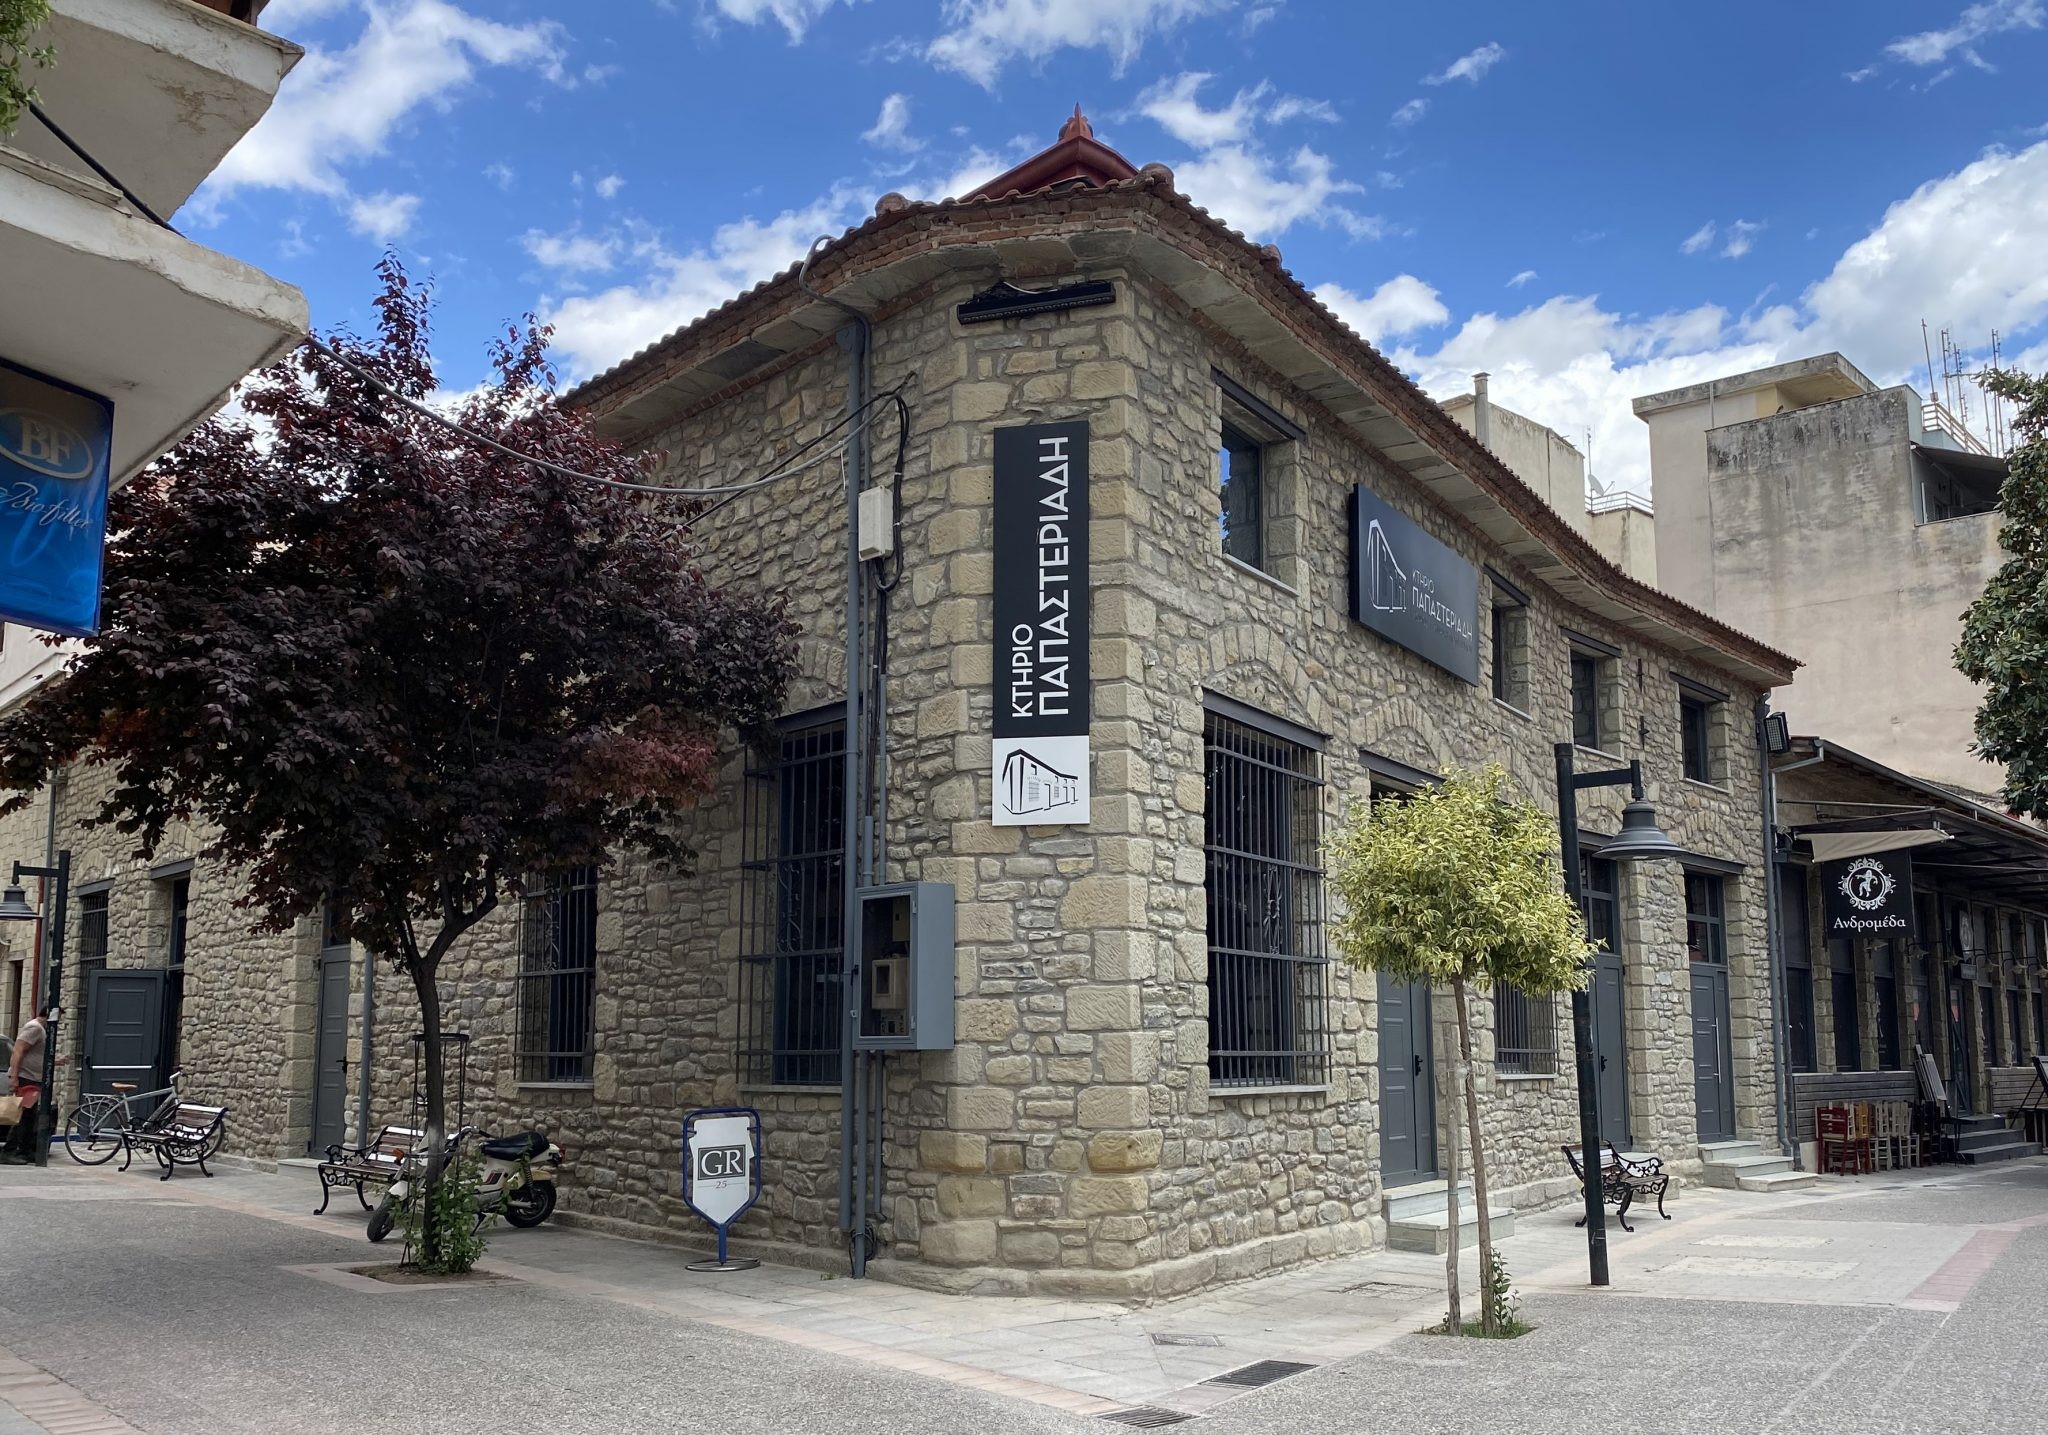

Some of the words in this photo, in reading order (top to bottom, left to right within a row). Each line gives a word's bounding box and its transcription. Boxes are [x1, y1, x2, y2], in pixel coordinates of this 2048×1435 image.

[18, 416, 72, 467] BF
[1038, 436, 1069, 717] ΠΑΠΑΣΤΕΡΙΑΔΗ
[1412, 569, 1435, 594] ΚΤΗΡΙΟ
[1412, 586, 1473, 641] ΠΑΠΑΣΤΕΡΙΑΔΗ
[1012, 622, 1034, 717] ΚΤΗΡΙΟ
[1833, 914, 1906, 933] Ανδρομέδα
[700, 1148, 743, 1177] GR
